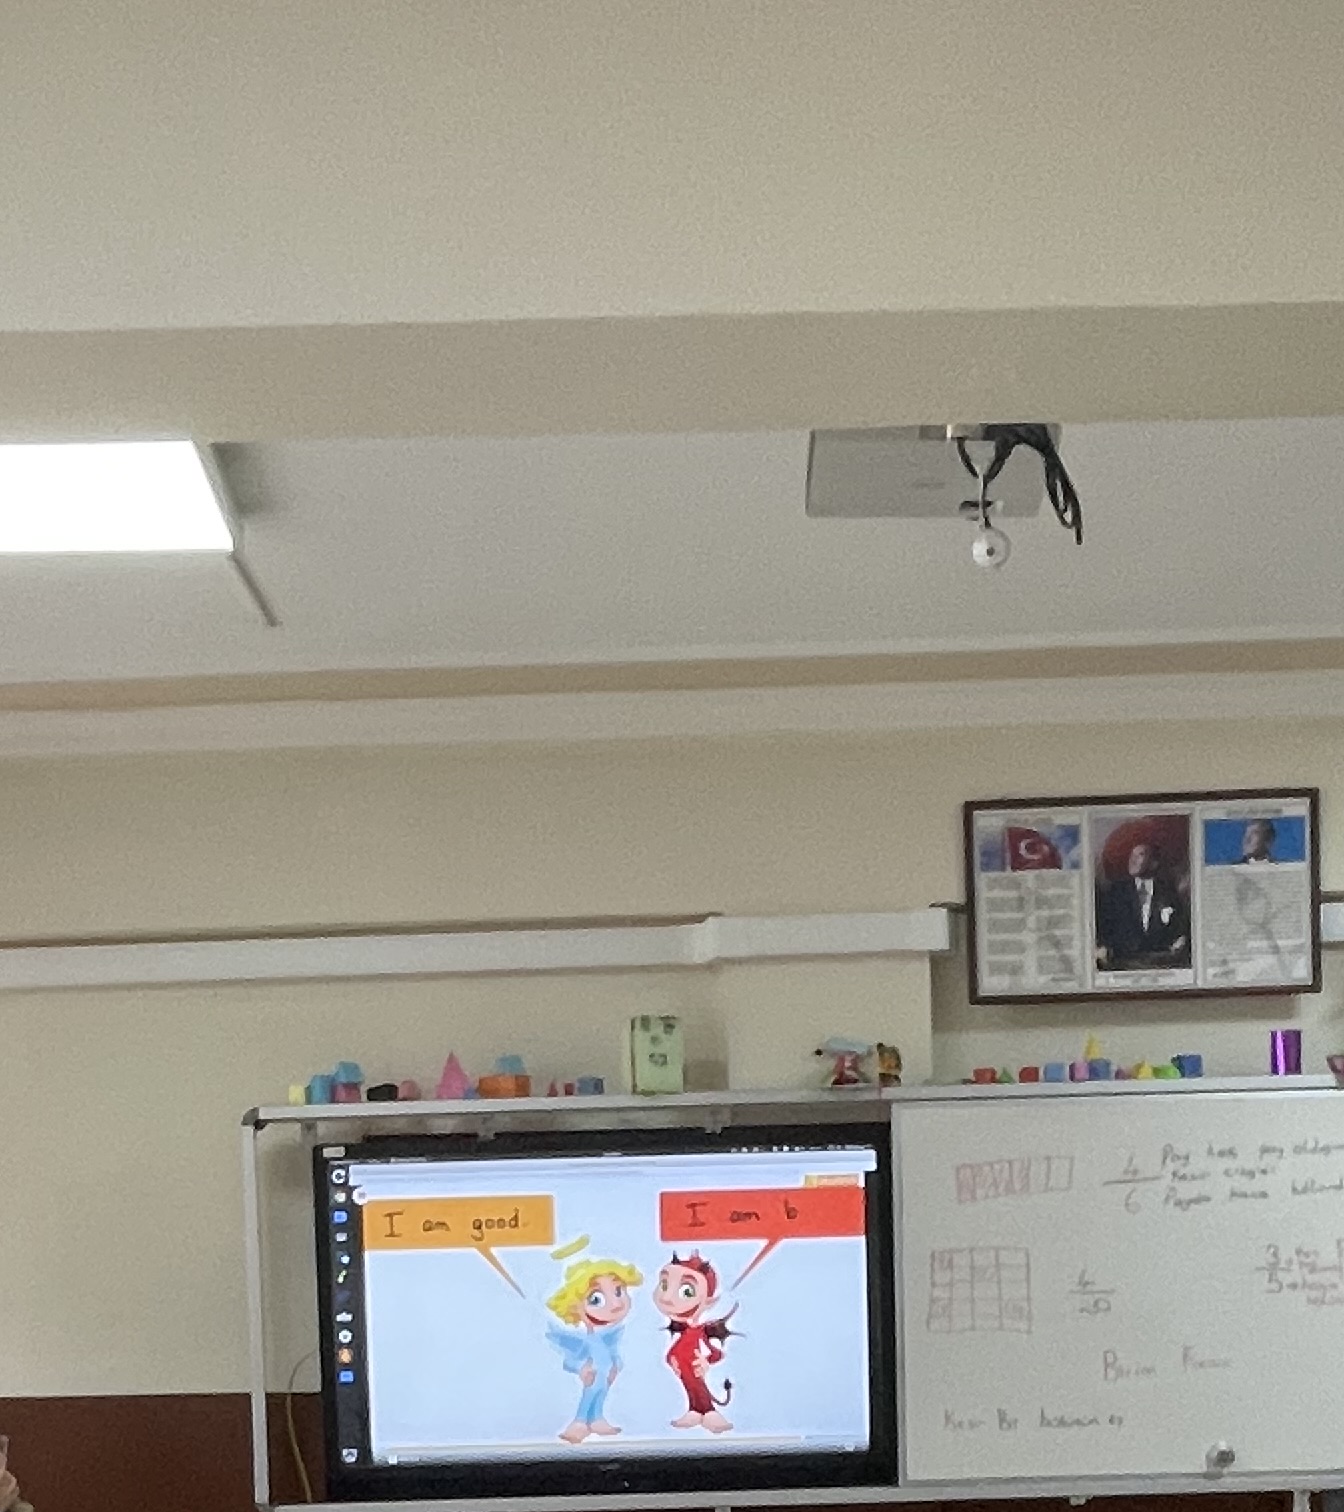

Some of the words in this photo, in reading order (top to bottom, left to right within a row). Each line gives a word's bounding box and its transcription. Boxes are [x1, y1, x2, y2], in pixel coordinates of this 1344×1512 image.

[382, 1209, 405, 1238] I
[422, 1218, 451, 1232] am
[470, 1206, 520, 1242] good
[685, 1200, 709, 1228] I
[728, 1209, 760, 1224] am
[783, 1198, 799, 1220] b
